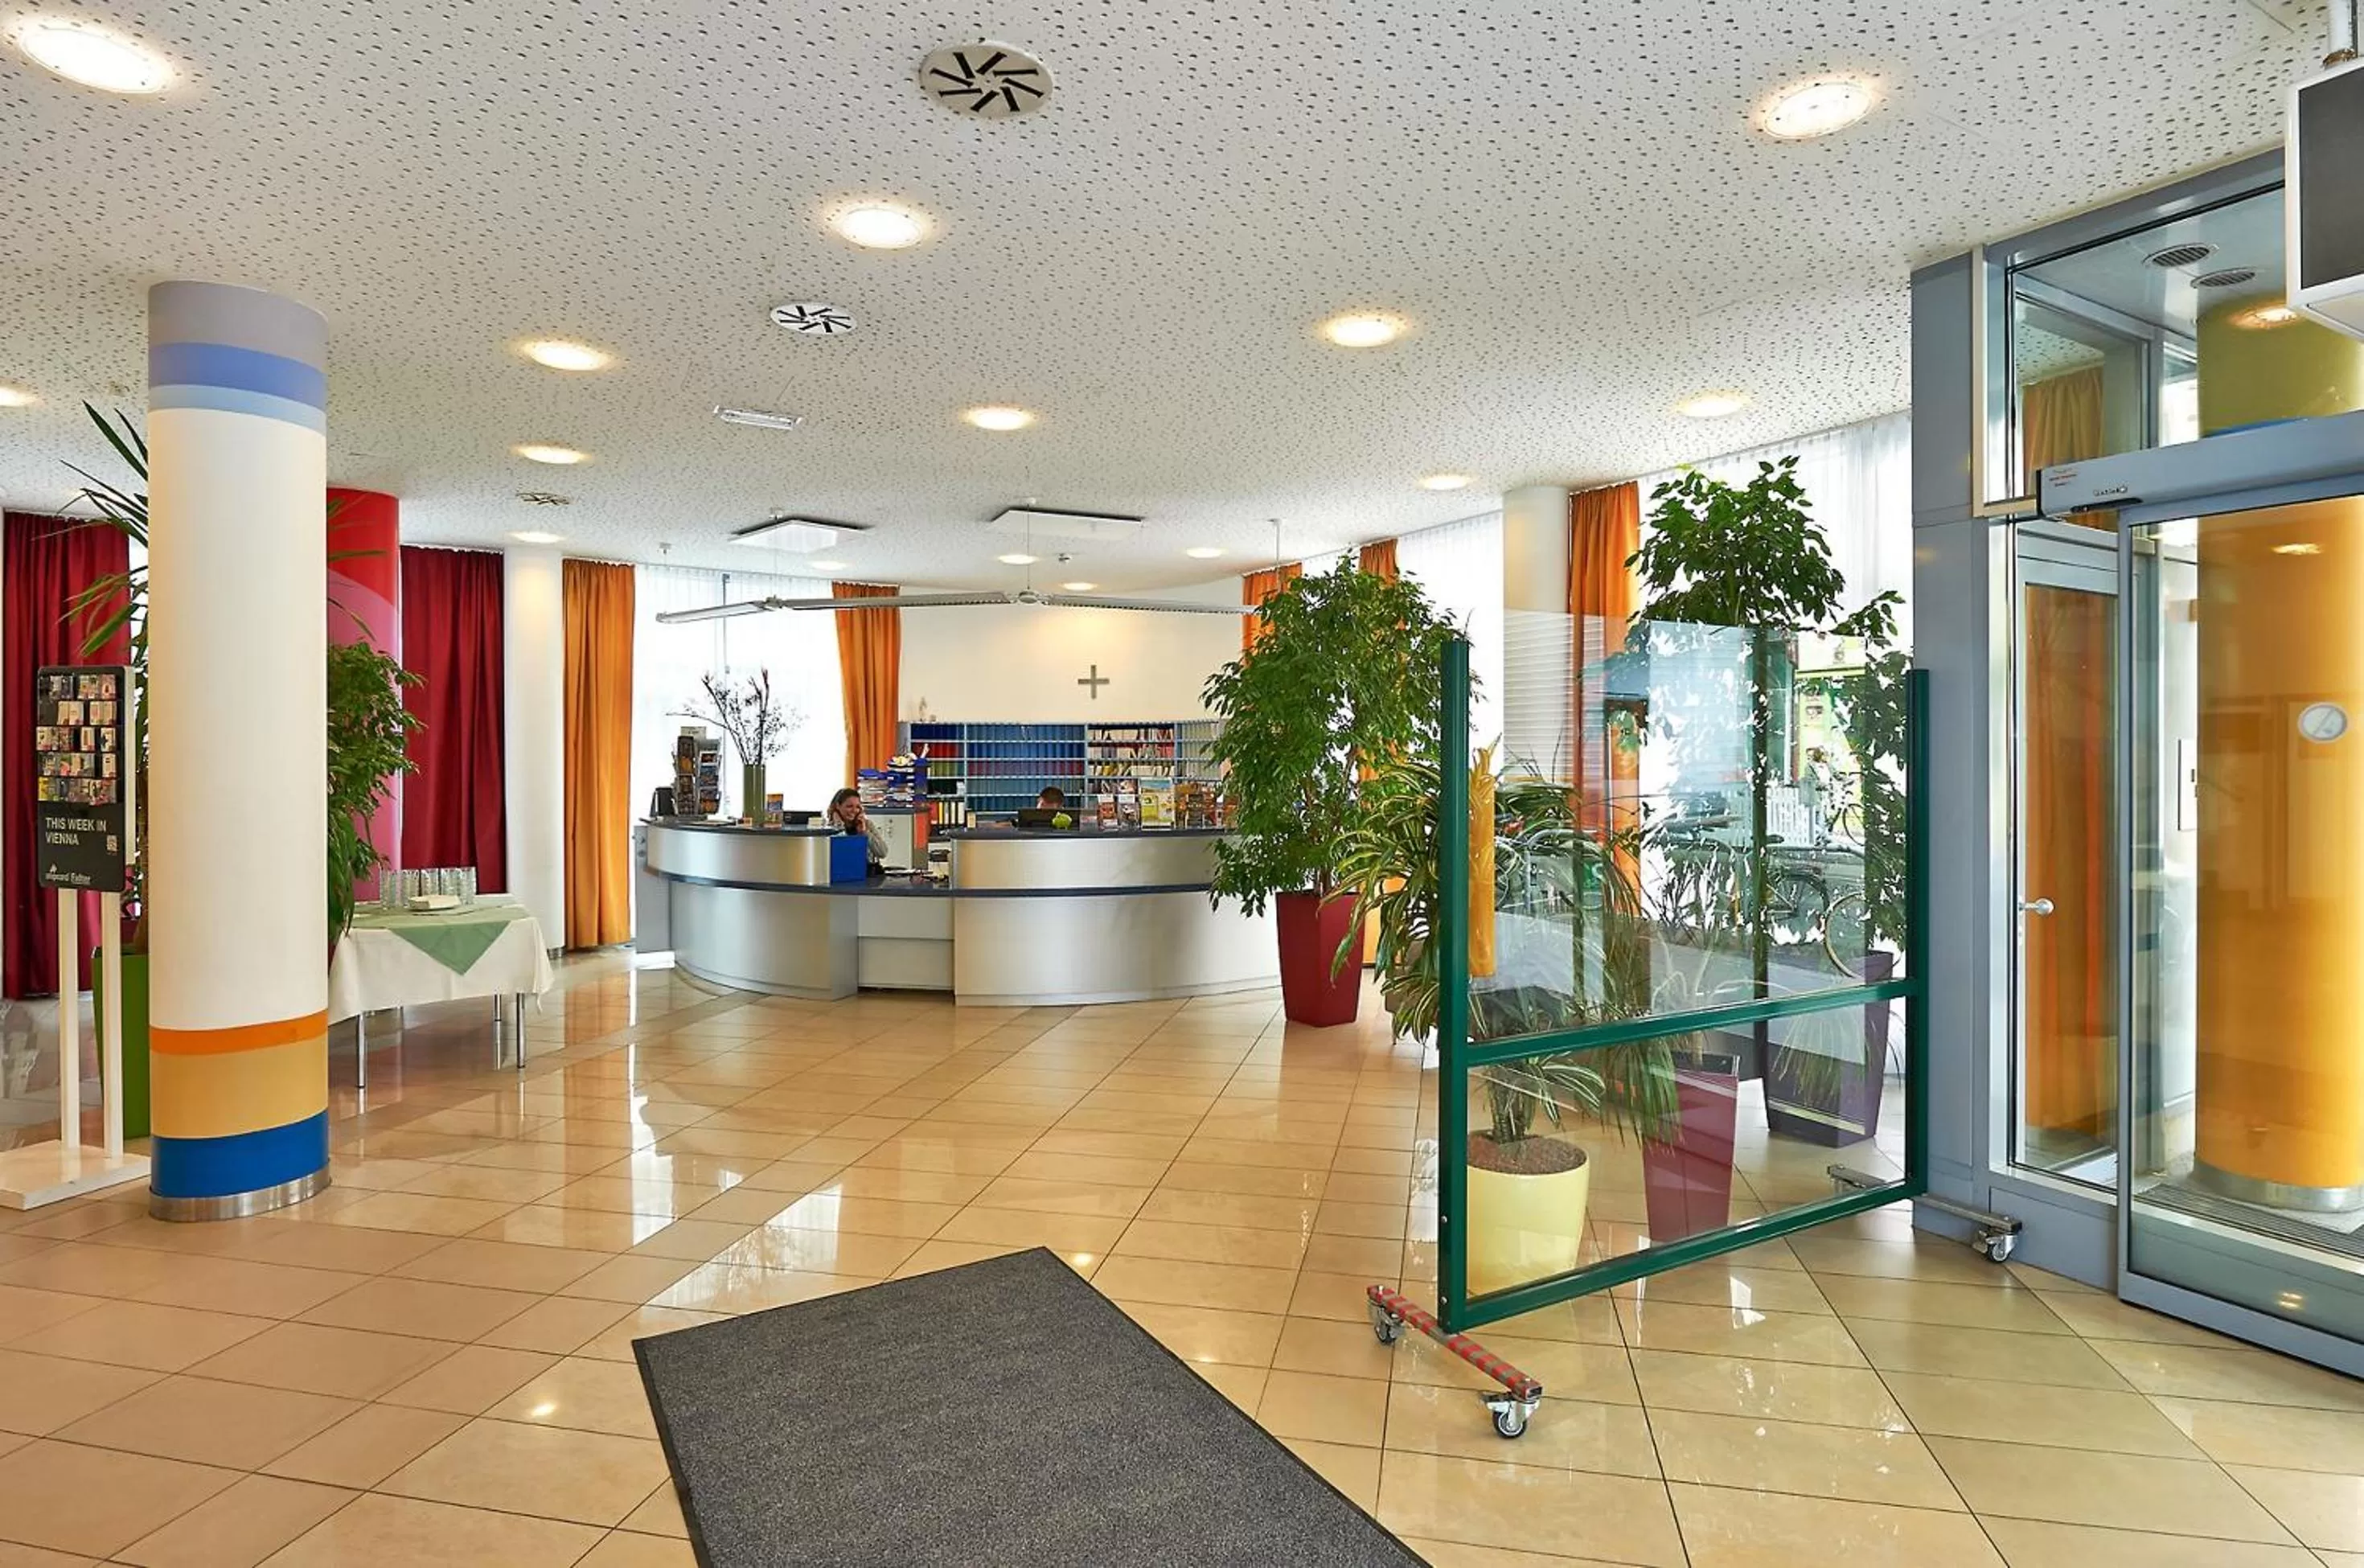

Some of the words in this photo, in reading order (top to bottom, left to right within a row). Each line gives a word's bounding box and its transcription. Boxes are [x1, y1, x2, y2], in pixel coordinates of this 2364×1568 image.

[45, 817, 65, 830] THIS
[68, 819, 95, 831] WEEK
[96, 819, 106, 832] IN
[45, 831, 80, 846] VIENNA
